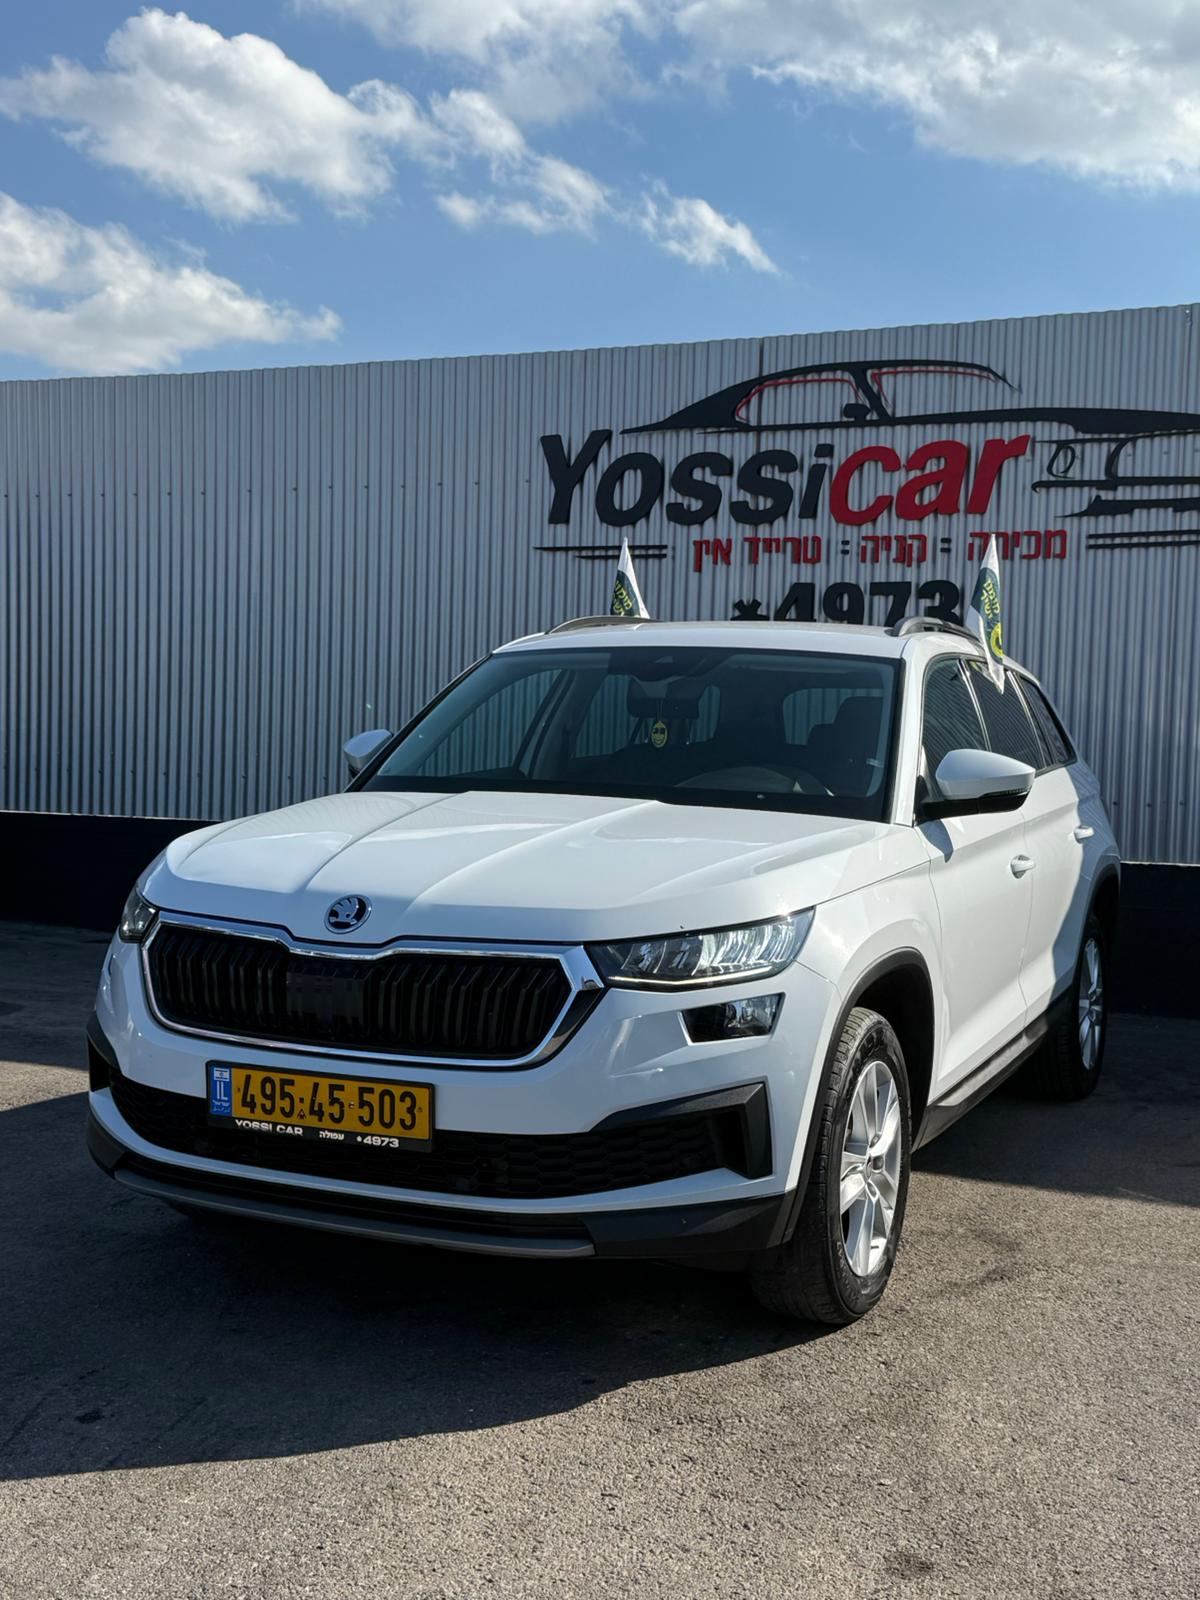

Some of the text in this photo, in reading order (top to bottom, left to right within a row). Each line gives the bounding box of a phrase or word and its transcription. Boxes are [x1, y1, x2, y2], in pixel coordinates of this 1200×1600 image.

[540, 428, 1031, 527] Yossicar
[693, 537, 732, 572] אין
[743, 535, 822, 565] טרייד
[860, 534, 927, 567] קניה
[967, 529, 1067, 561] מכירה
[216, 1081, 229, 1100] IL
[235, 1119, 303, 1136] YOSSI CAR
[319, 1130, 344, 1141] עפולה
